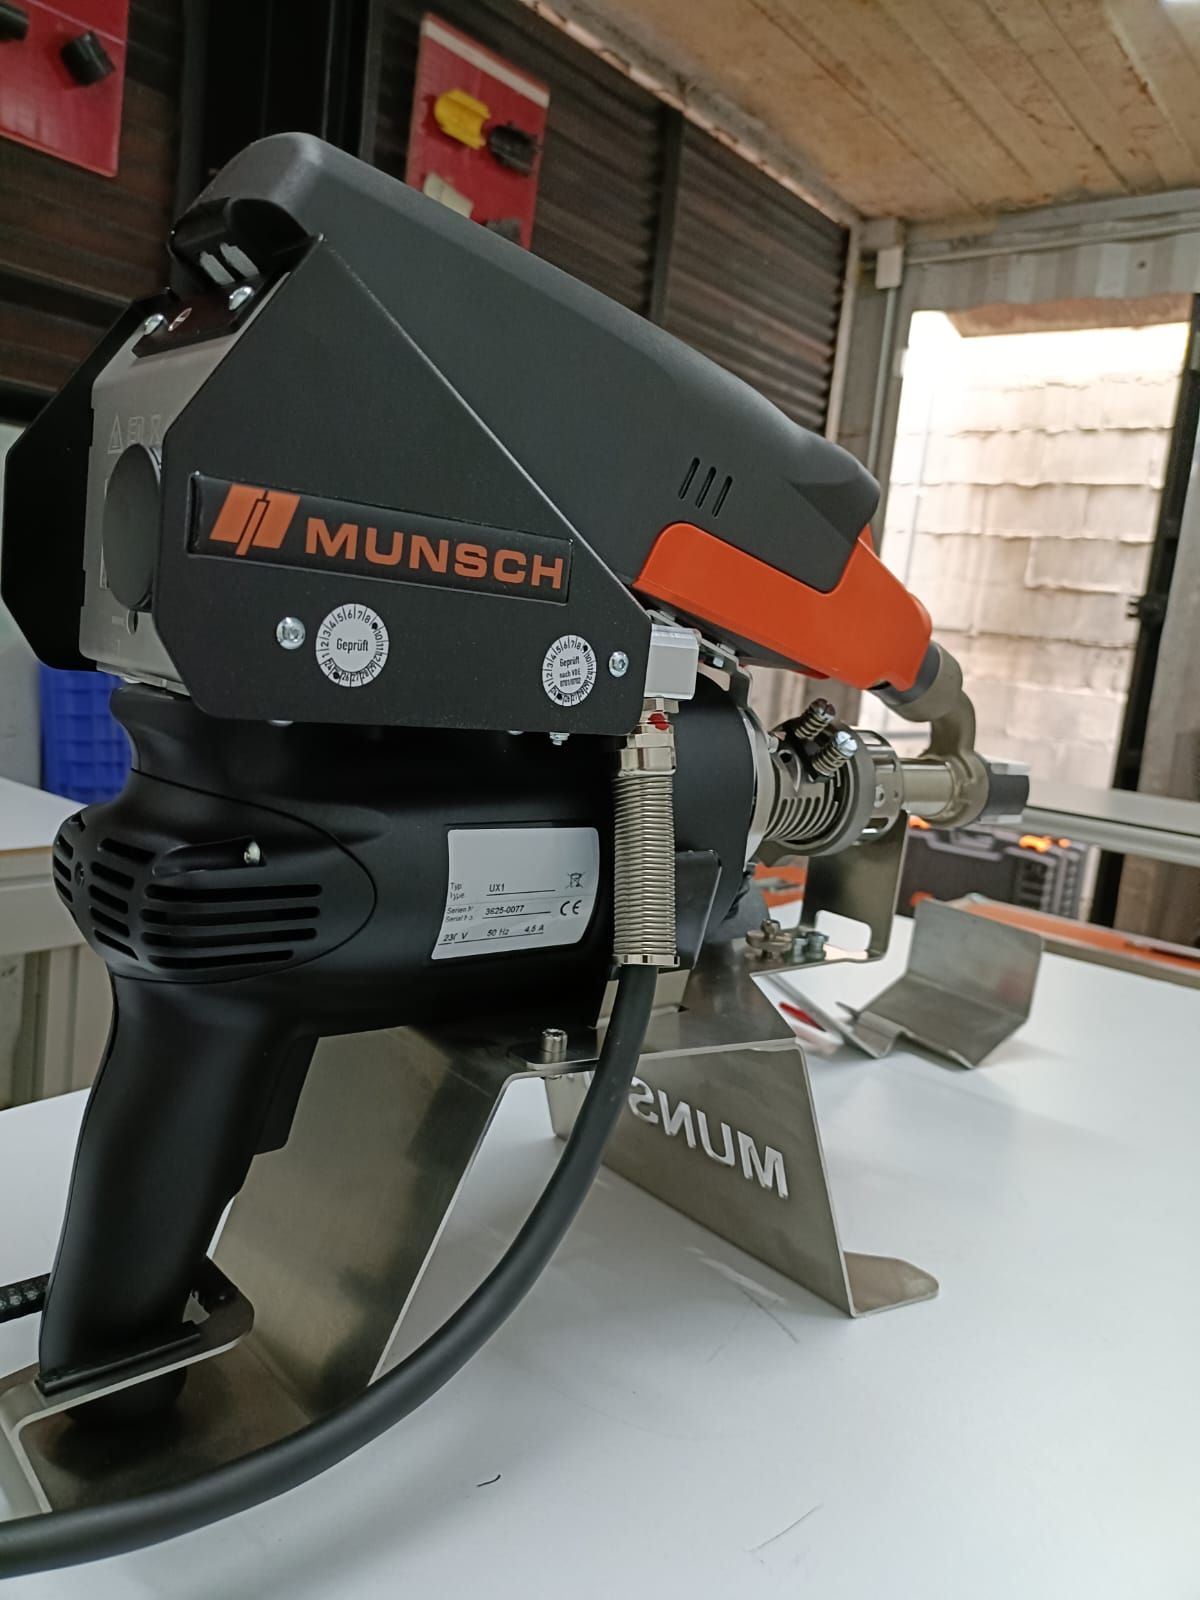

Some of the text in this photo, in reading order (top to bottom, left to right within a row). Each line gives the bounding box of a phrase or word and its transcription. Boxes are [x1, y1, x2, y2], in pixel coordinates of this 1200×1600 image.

[305, 517, 564, 589] MUNSCH
[329, 620, 336, 629] 4
[337, 613, 344, 622] 5
[347, 609, 353, 619] 6
[357, 610, 363, 620] 7
[364, 615, 371, 624] 8
[374, 630, 383, 641] 10
[336, 638, 369, 654] Geprüft
[450, 882, 462, 891] Typ
[489, 883, 505, 892] UX1
[560, 900, 582, 916] CE
[461, 931, 469, 940] V
[487, 928, 497, 937] 50
[499, 928, 510, 936] Hz
